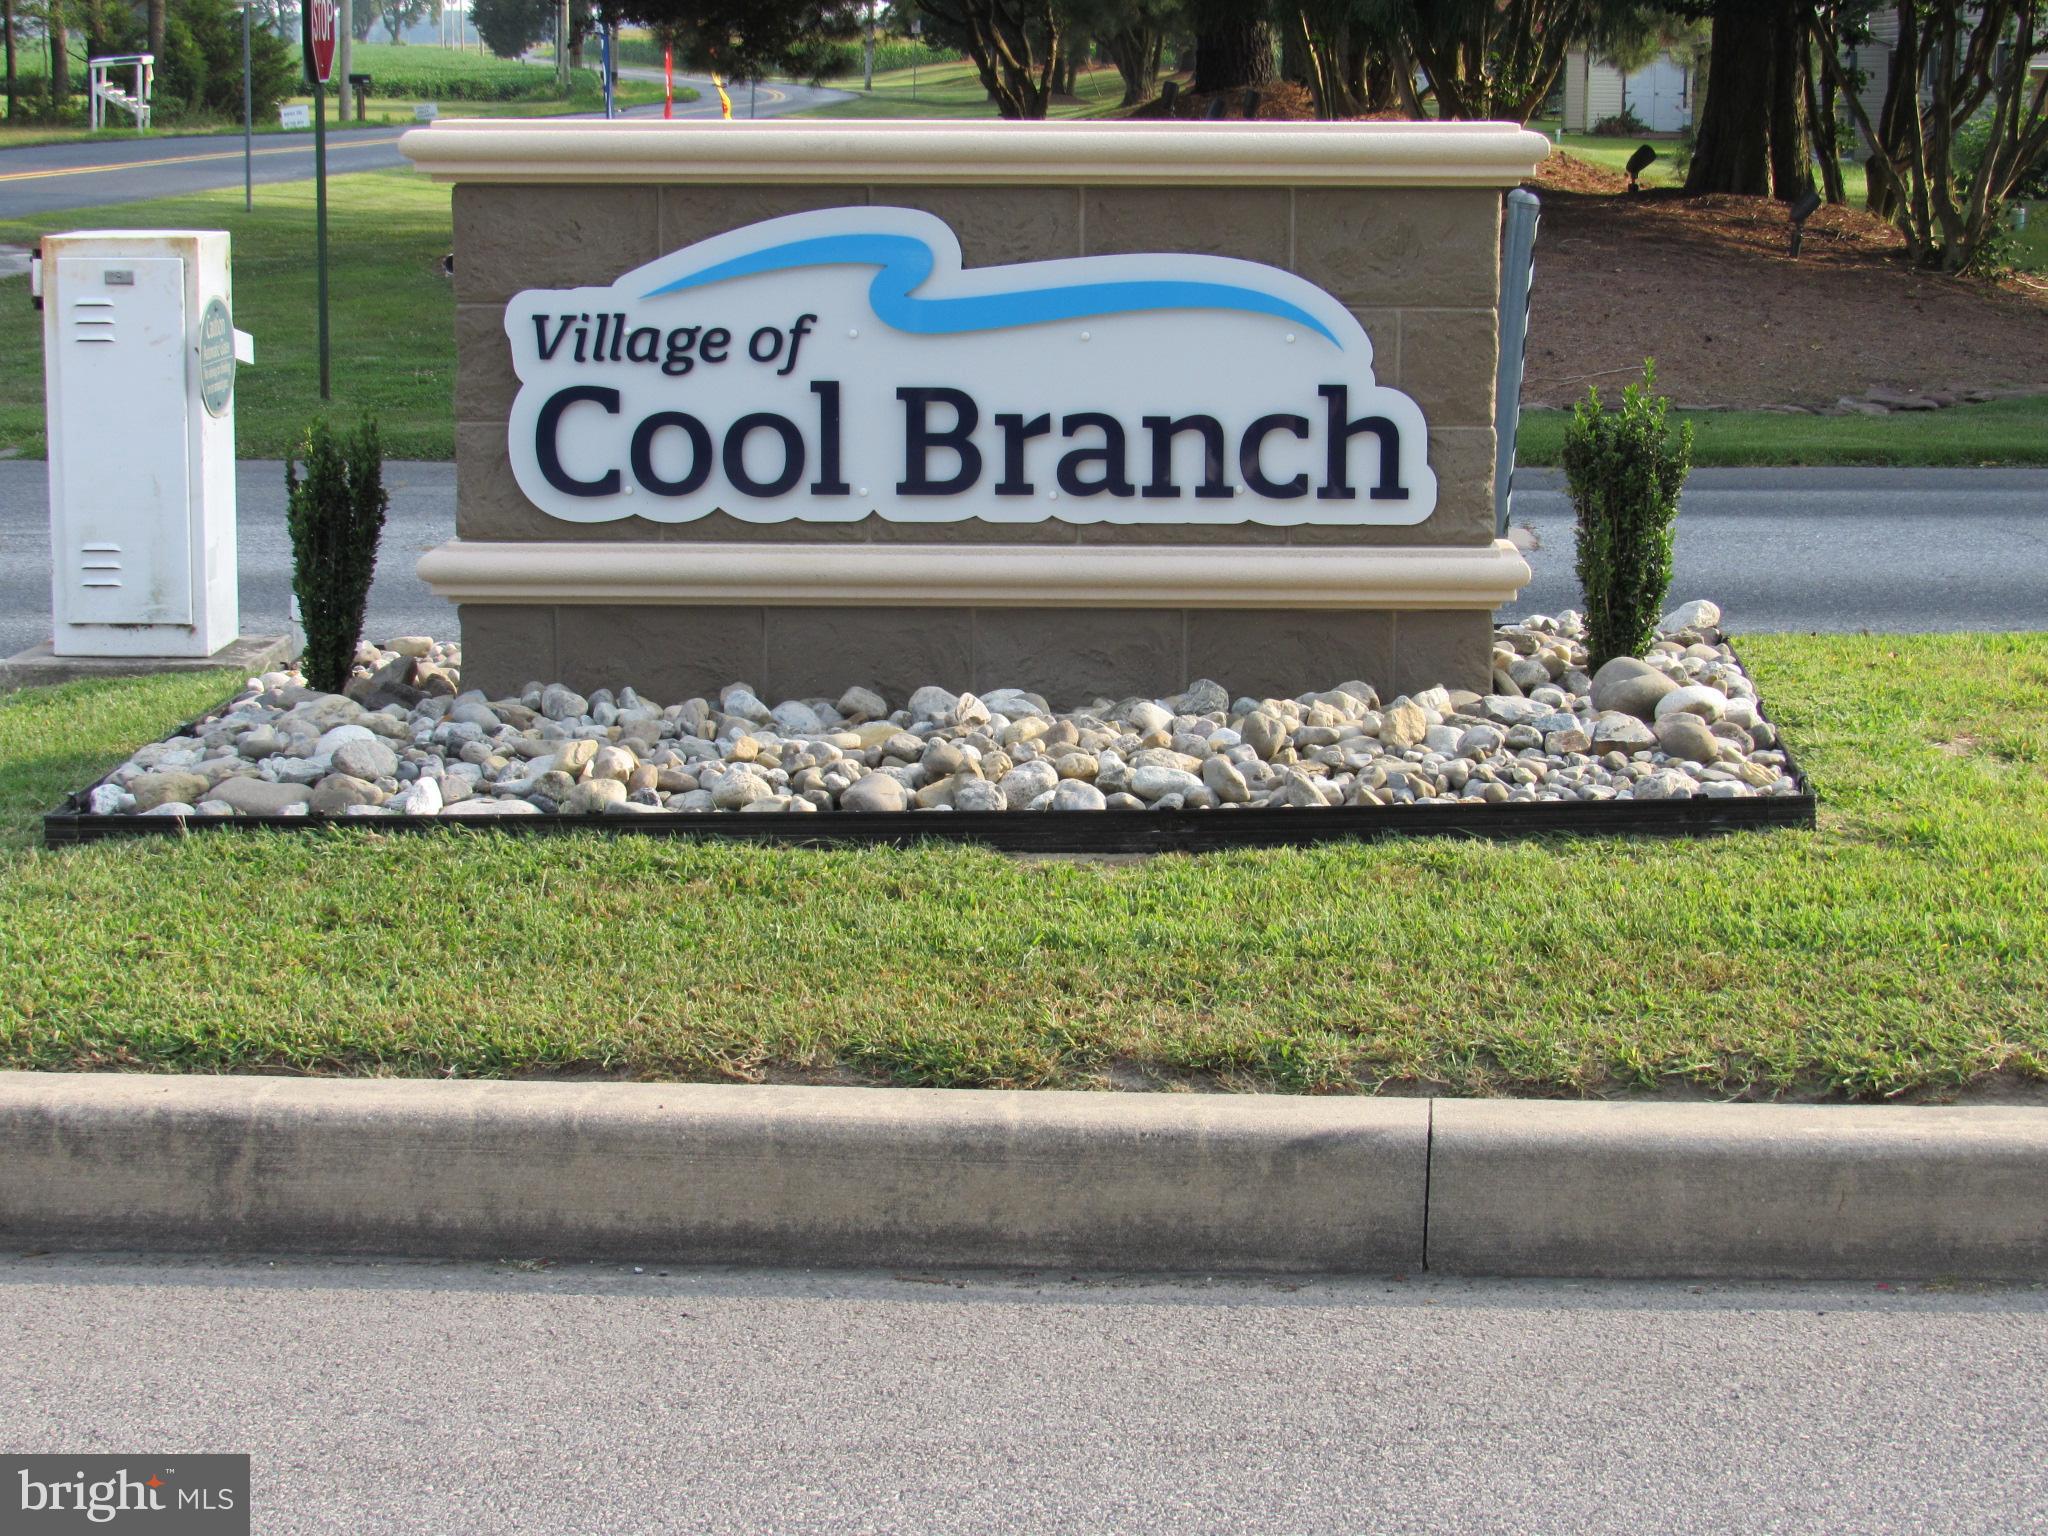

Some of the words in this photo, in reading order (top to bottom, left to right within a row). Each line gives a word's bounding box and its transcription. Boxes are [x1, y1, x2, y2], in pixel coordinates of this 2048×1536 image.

[313, 0, 333, 41] STOP
[532, 313, 731, 376] Village
[748, 313, 818, 376] of
[535, 380, 851, 497] Cool
[896, 384, 1409, 500] Branch
